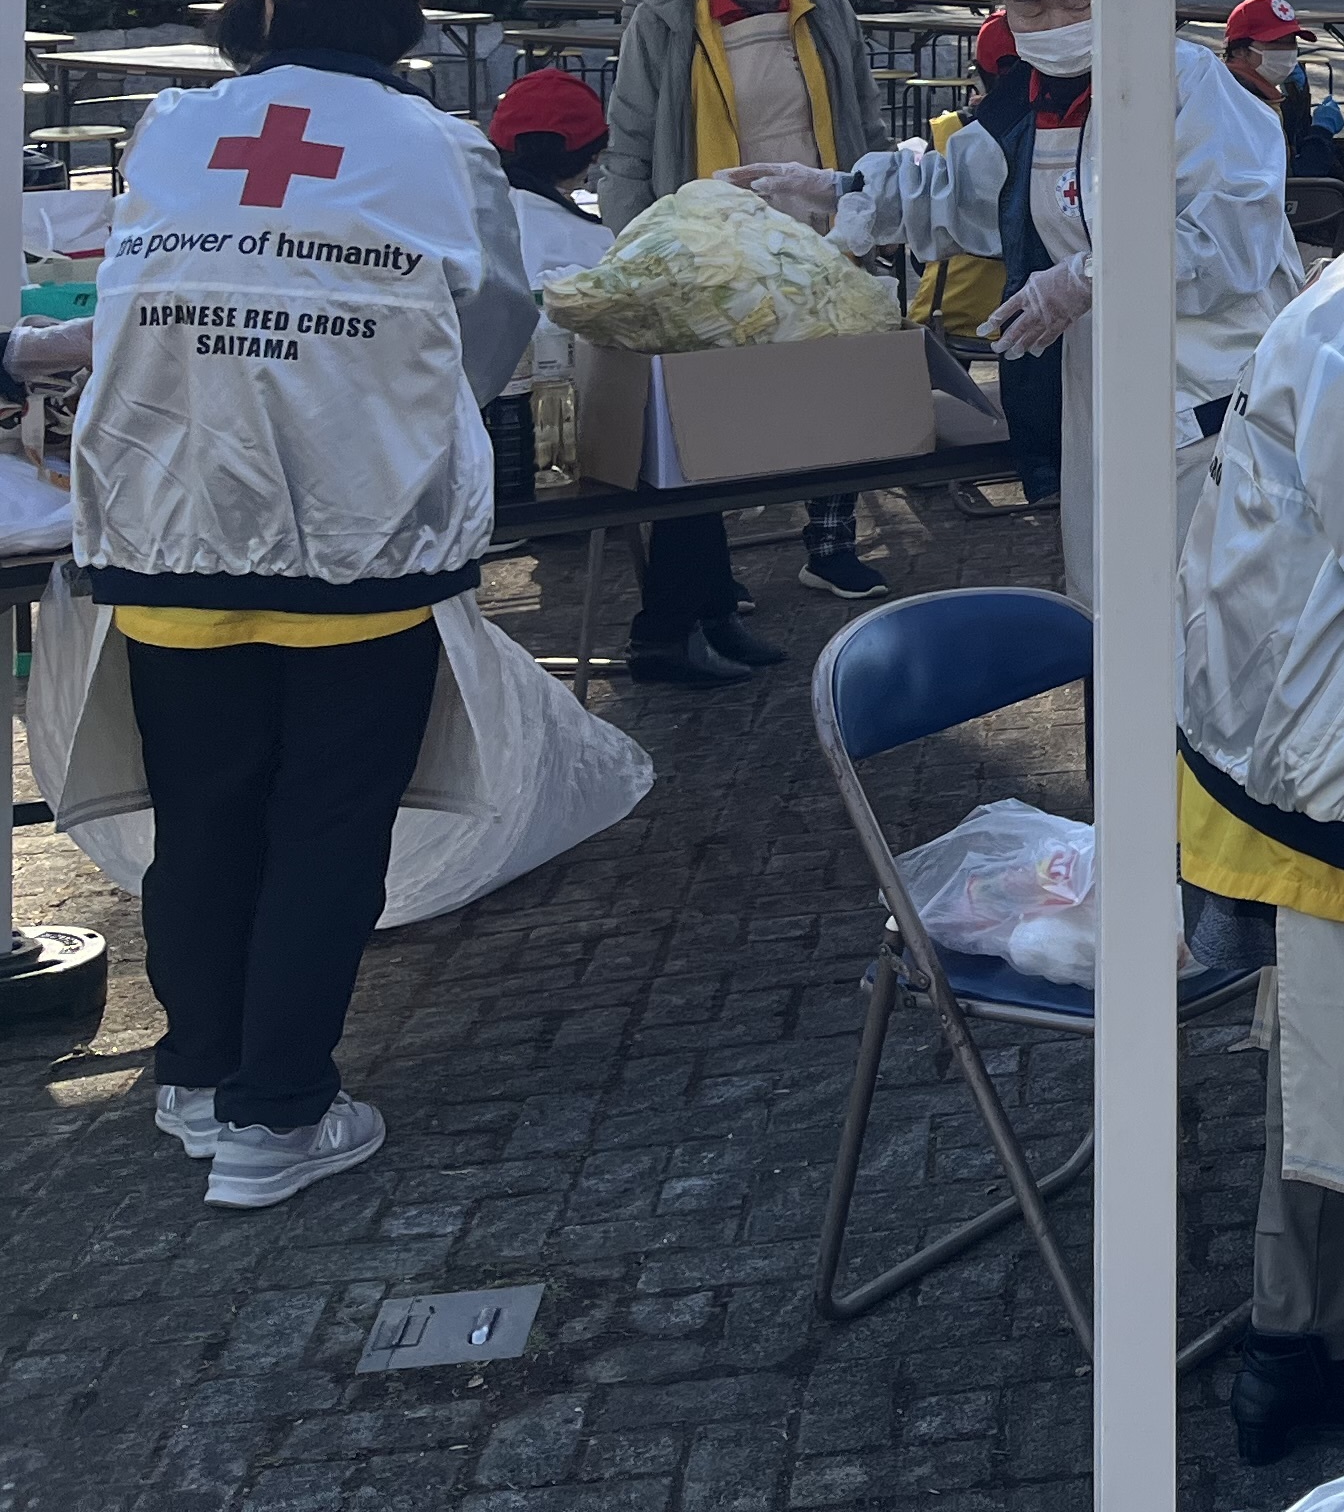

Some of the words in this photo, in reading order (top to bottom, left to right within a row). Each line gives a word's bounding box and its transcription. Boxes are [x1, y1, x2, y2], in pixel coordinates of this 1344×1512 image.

[145, 232, 233, 259] power
[238, 231, 270, 256] of
[276, 232, 423, 276] humanity
[139, 304, 238, 328] JAPANESE
[244, 309, 290, 331] RED
[297, 313, 377, 339] CROSS
[196, 334, 299, 361] SAITAMA
